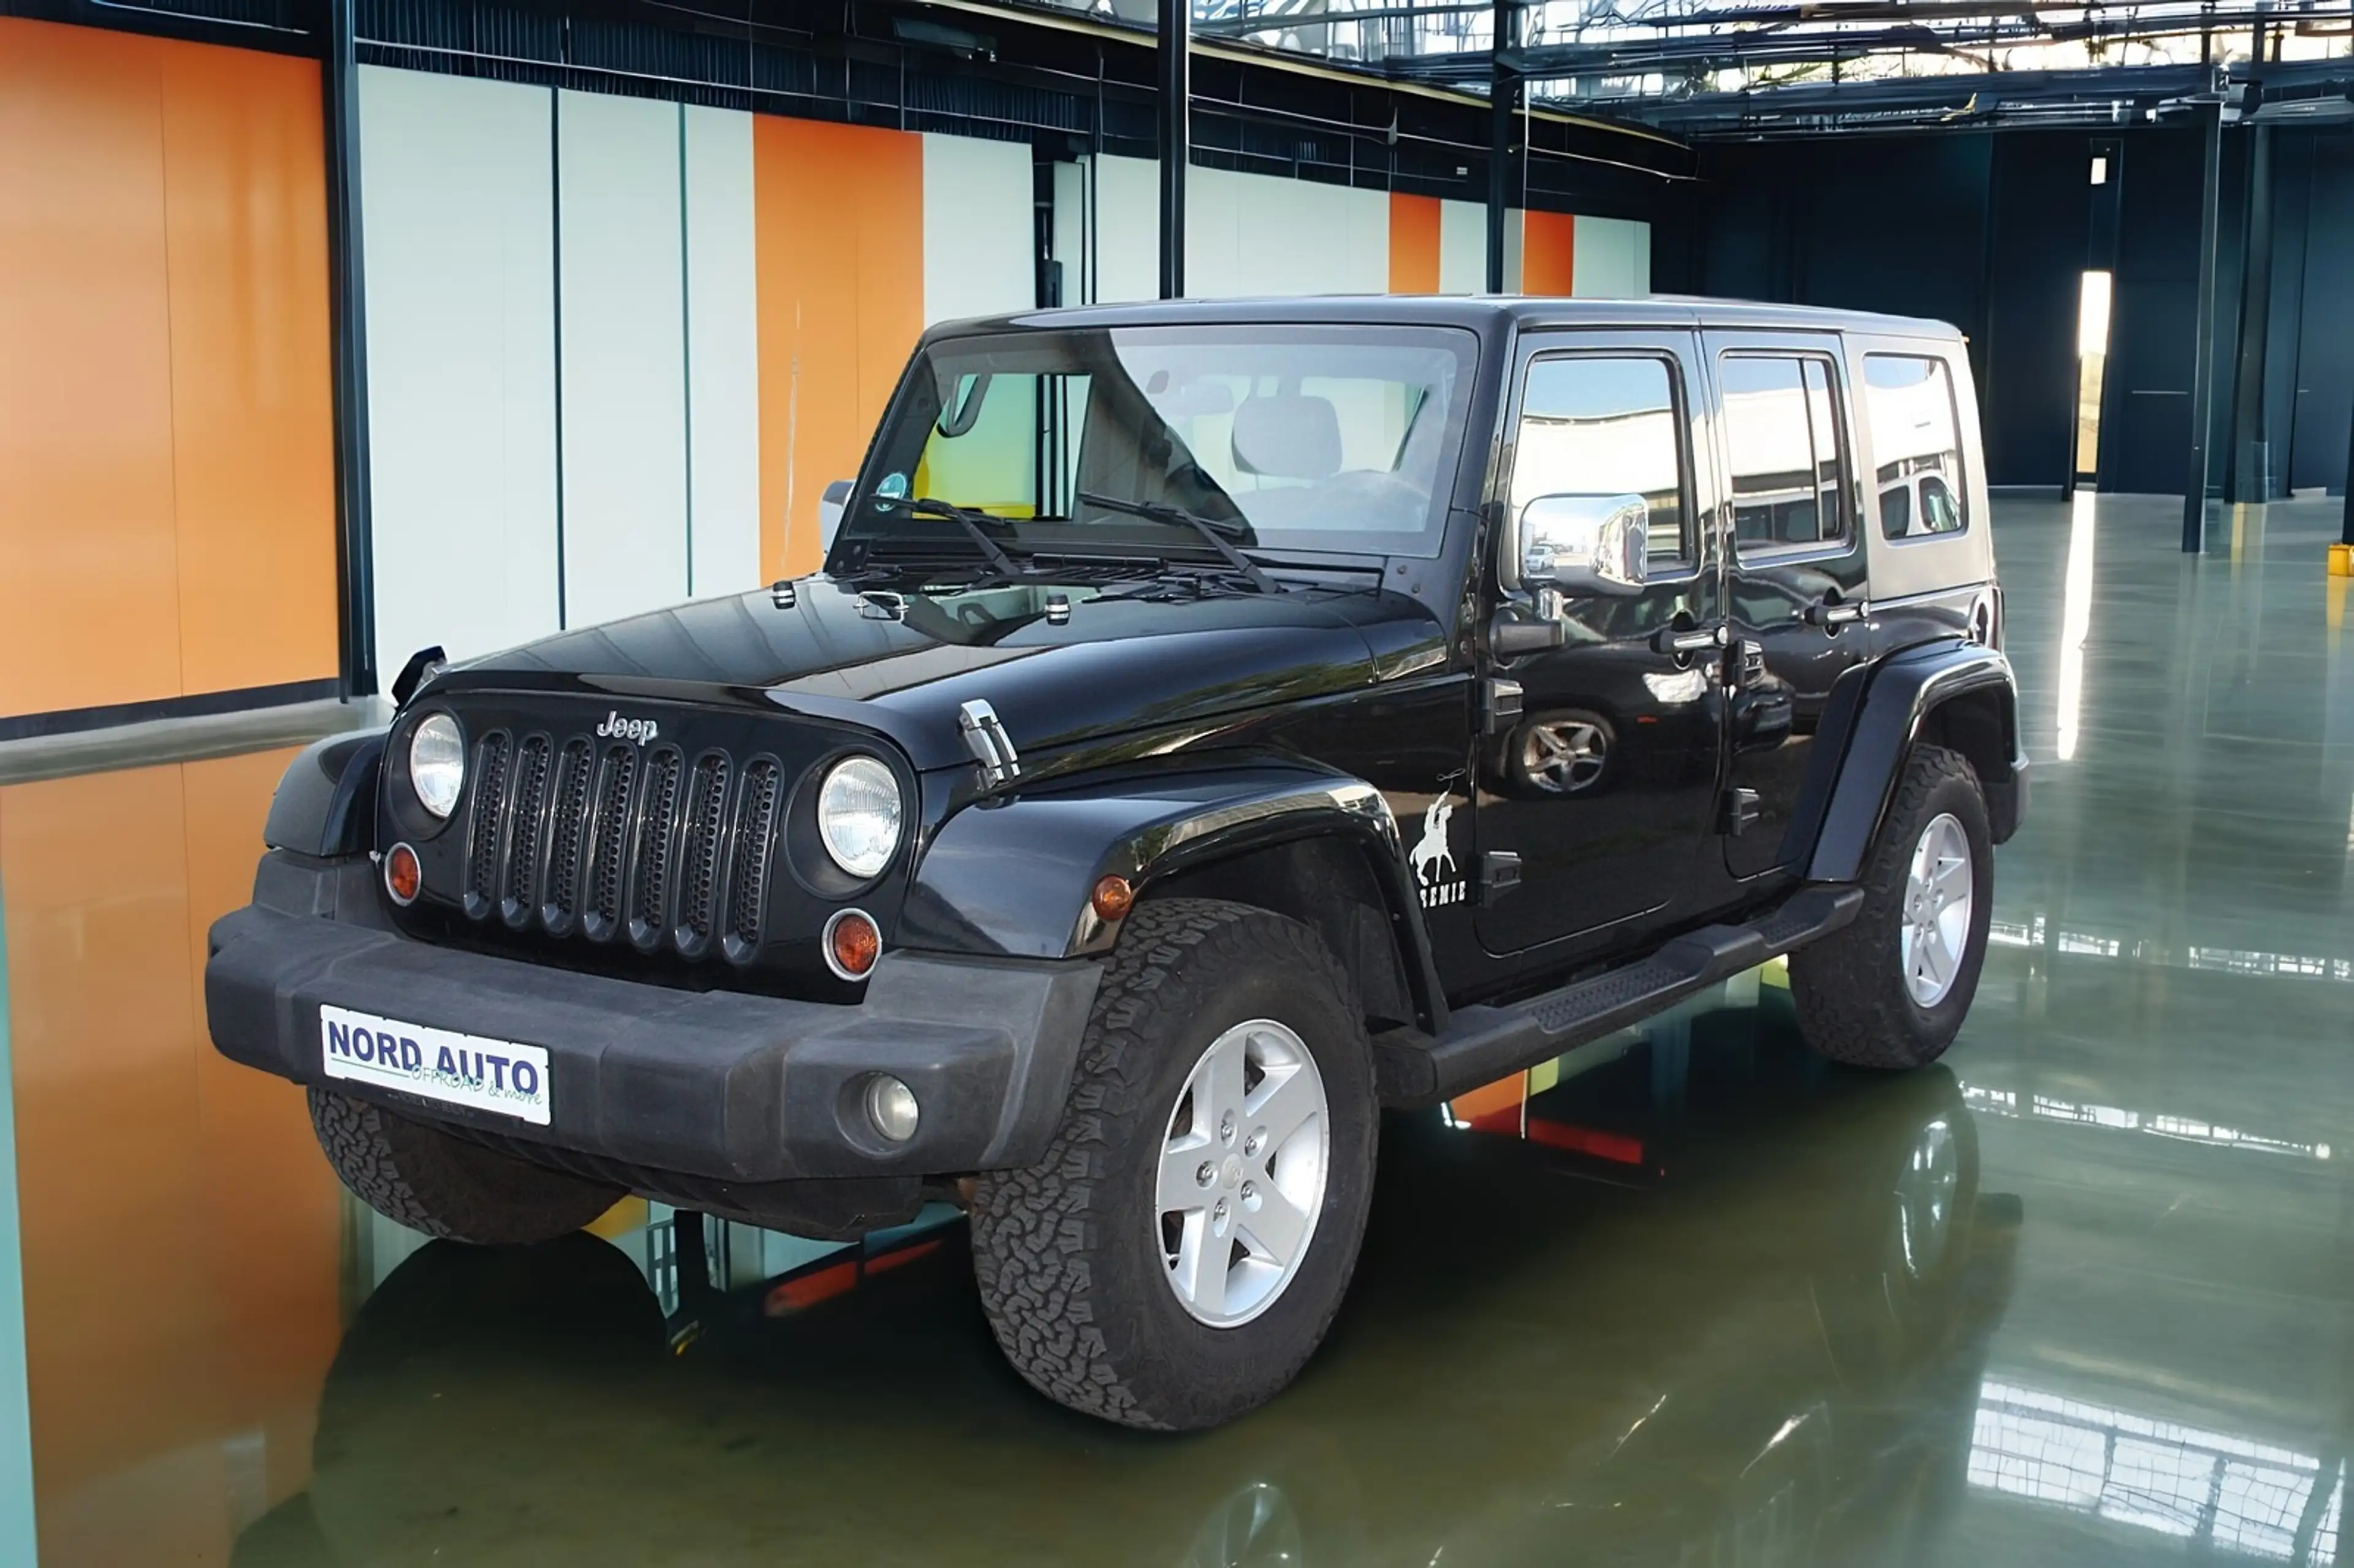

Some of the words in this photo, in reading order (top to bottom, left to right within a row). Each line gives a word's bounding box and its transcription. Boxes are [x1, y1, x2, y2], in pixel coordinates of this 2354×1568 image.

[596, 710, 658, 747] Jeep
[329, 1021, 422, 1071] NORD
[437, 1046, 538, 1095] AUTO
[411, 1064, 484, 1092] OFFROAD
[505, 1088, 543, 1106] more
